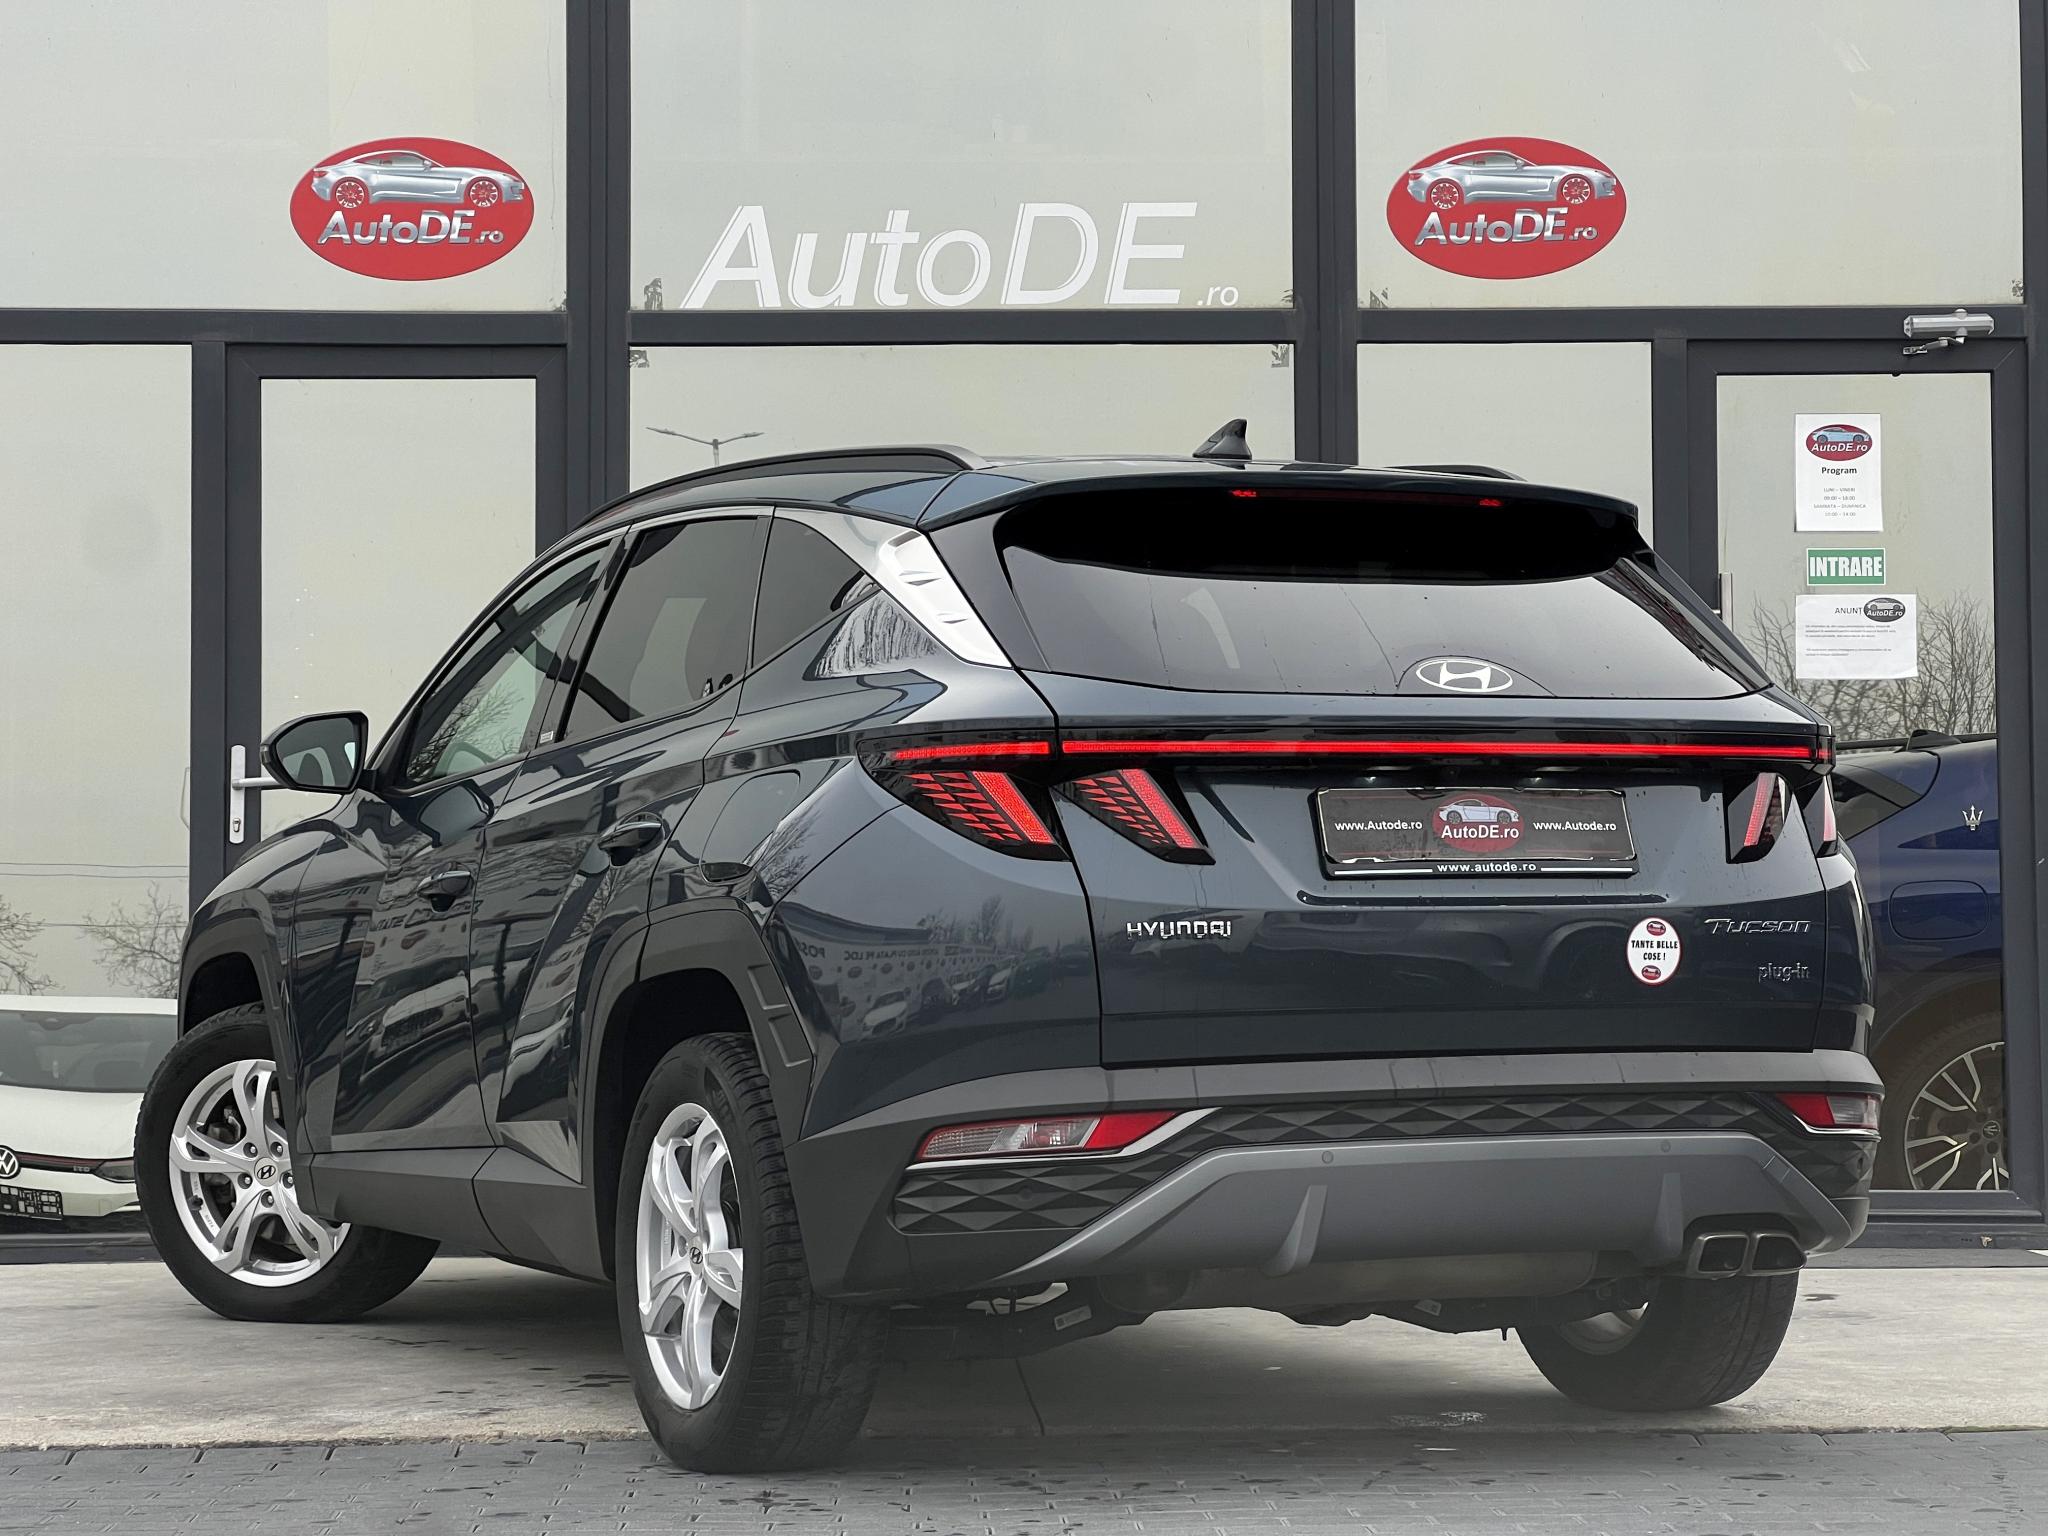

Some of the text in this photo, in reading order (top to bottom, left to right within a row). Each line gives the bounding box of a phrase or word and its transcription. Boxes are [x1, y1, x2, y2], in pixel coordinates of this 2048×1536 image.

[1811, 442, 1868, 453] AutoDE.ro
[1821, 466, 1858, 476] Program
[1809, 556, 1883, 577] INTRARE
[1334, 819, 1423, 832] www.Autode.ro
[1441, 824, 1519, 840] AutoDE.ro
[1533, 819, 1617, 832] www.Autode.ro
[1436, 862, 1537, 873] www.autode.ro
[1126, 920, 1233, 940] HYUNDAI
[1631, 939, 1679, 949] TANTE BELLE
[1643, 952, 1662, 961] COSE
[1758, 961, 1810, 984] plug-in
